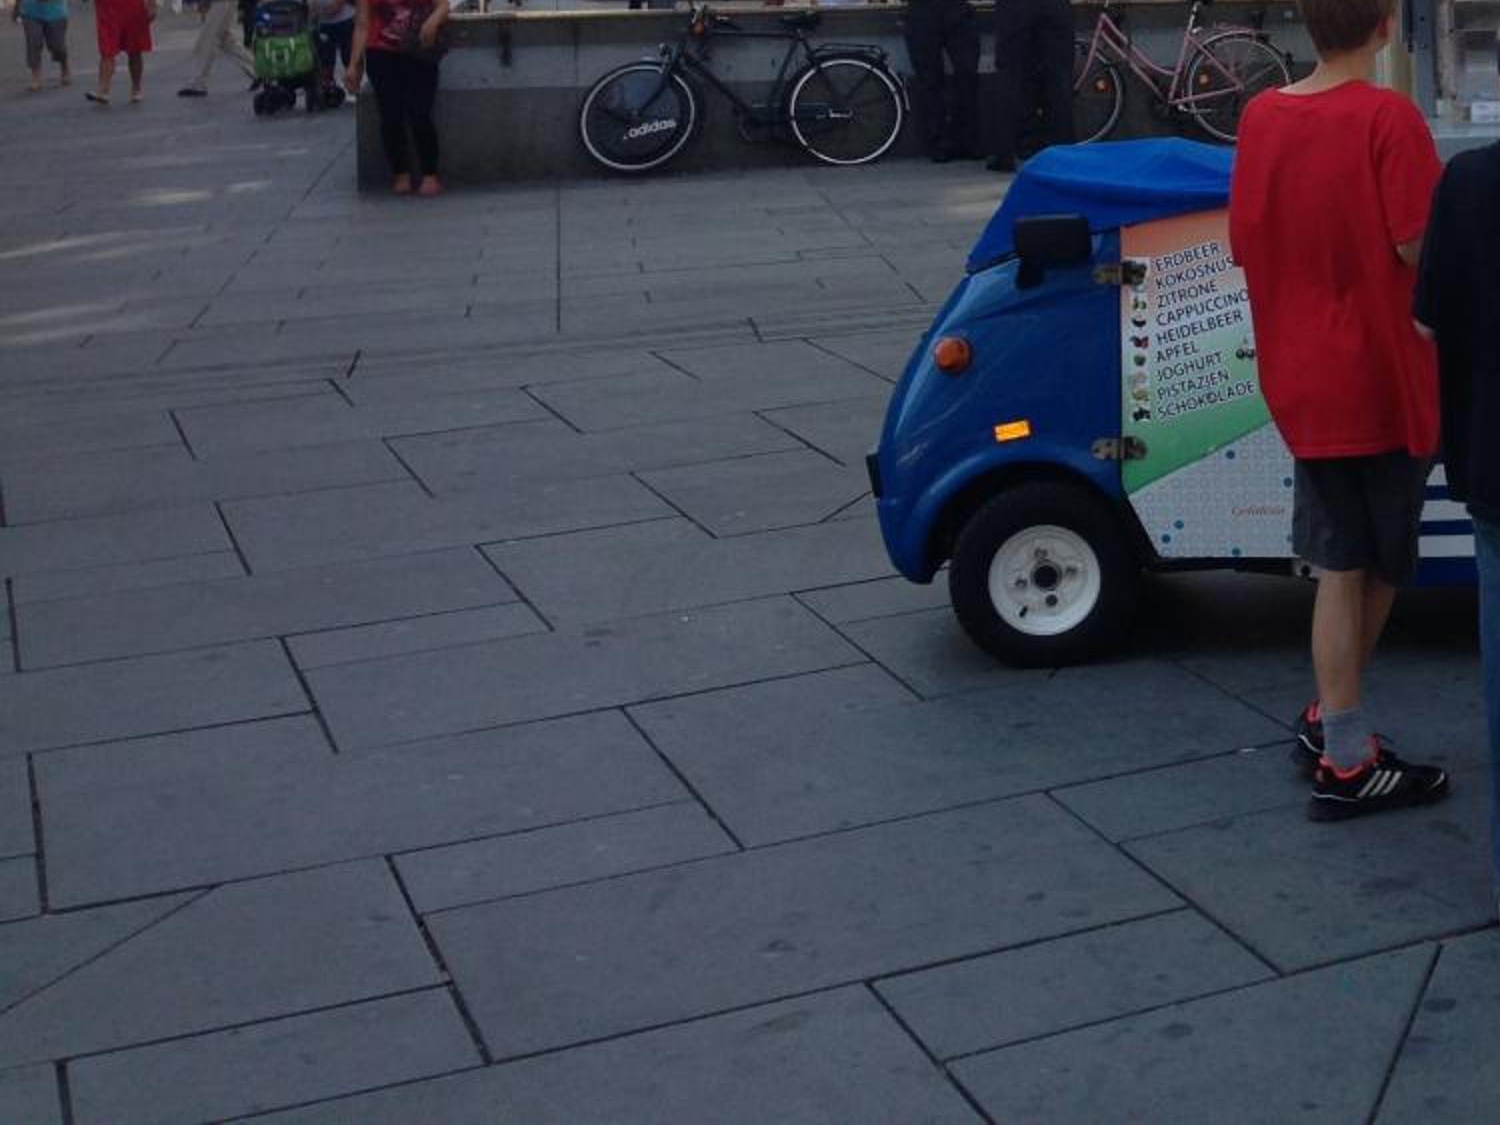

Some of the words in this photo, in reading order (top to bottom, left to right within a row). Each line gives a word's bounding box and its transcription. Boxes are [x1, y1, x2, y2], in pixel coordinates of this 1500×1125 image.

[627, 119, 677, 138] adidas
[1155, 242, 1220, 271] ERDBEER
[1155, 288, 1249, 326] CAPPUCCINO
[1156, 279, 1219, 308] ZITRONE
[1156, 309, 1244, 345] HEIDELBEER
[1156, 340, 1200, 364] APFEL
[1156, 351, 1223, 382] JOGHURT
[1157, 369, 1230, 401] PISTAZIEN
[1157, 381, 1255, 418] SCHOKOLADE
